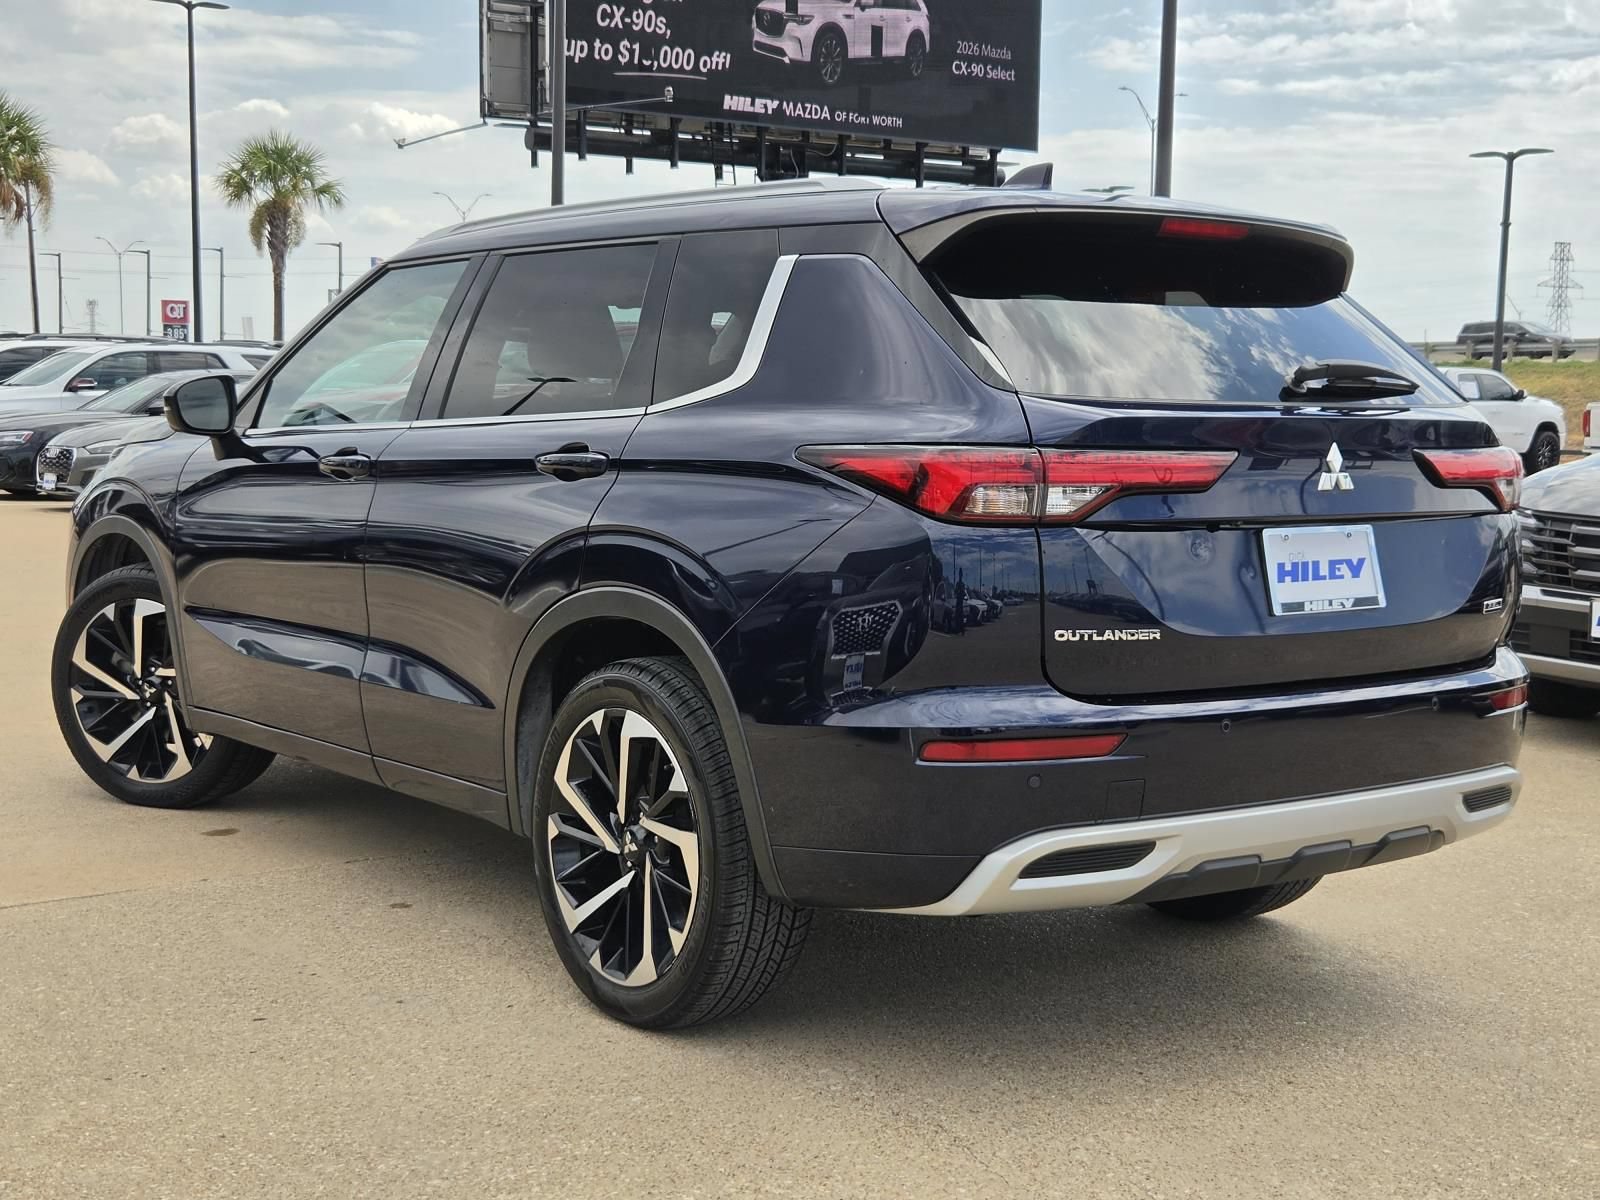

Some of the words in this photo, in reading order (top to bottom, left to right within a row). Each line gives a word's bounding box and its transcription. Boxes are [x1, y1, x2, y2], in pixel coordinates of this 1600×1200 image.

[596, 3, 671, 39] CX-90s,
[564, 38, 588, 63] up
[593, 37, 613, 61] to
[618, 38, 695, 71] $1,000
[956, 40, 980, 56] 2026
[981, 43, 1012, 60] Mazda
[952, 60, 985, 78] CX-90
[986, 64, 1016, 81] Select
[723, 94, 780, 115] HILEY
[782, 100, 831, 121] MAZDA
[834, 110, 847, 123] OF
[871, 114, 903, 128] WORTH
[1276, 557, 1367, 584] HILEY
[1303, 598, 1356, 612] HILEY
[1054, 628, 1161, 641] OUTLANDER
